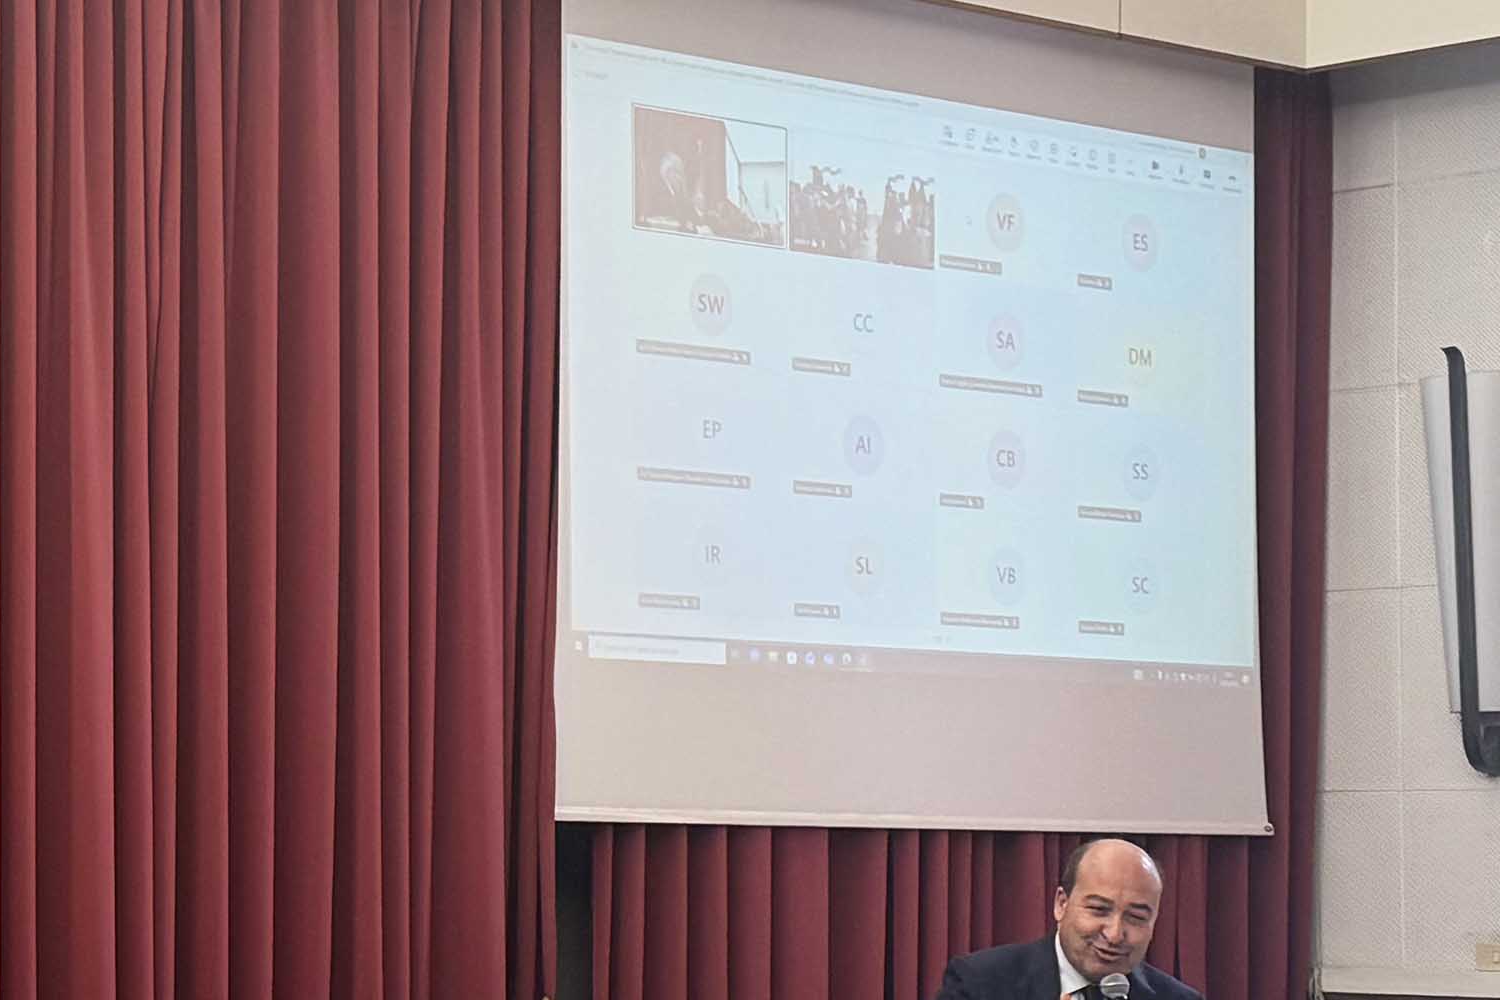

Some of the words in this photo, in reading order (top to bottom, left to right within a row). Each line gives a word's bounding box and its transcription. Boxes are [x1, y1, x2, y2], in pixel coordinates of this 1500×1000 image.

[996, 212, 1016, 231] VF
[1132, 232, 1149, 252] ES
[697, 293, 725, 314] SW
[852, 313, 875, 334] CC
[995, 330, 1016, 350] SA
[1128, 347, 1153, 368] DM
[702, 419, 722, 440] EP
[855, 435, 871, 455] AI
[996, 449, 1016, 468] CB
[1132, 462, 1149, 481] SS
[705, 544, 721, 564] IR
[855, 555, 873, 575] SL
[995, 565, 1017, 585] VB
[1132, 576, 1150, 595] SC
